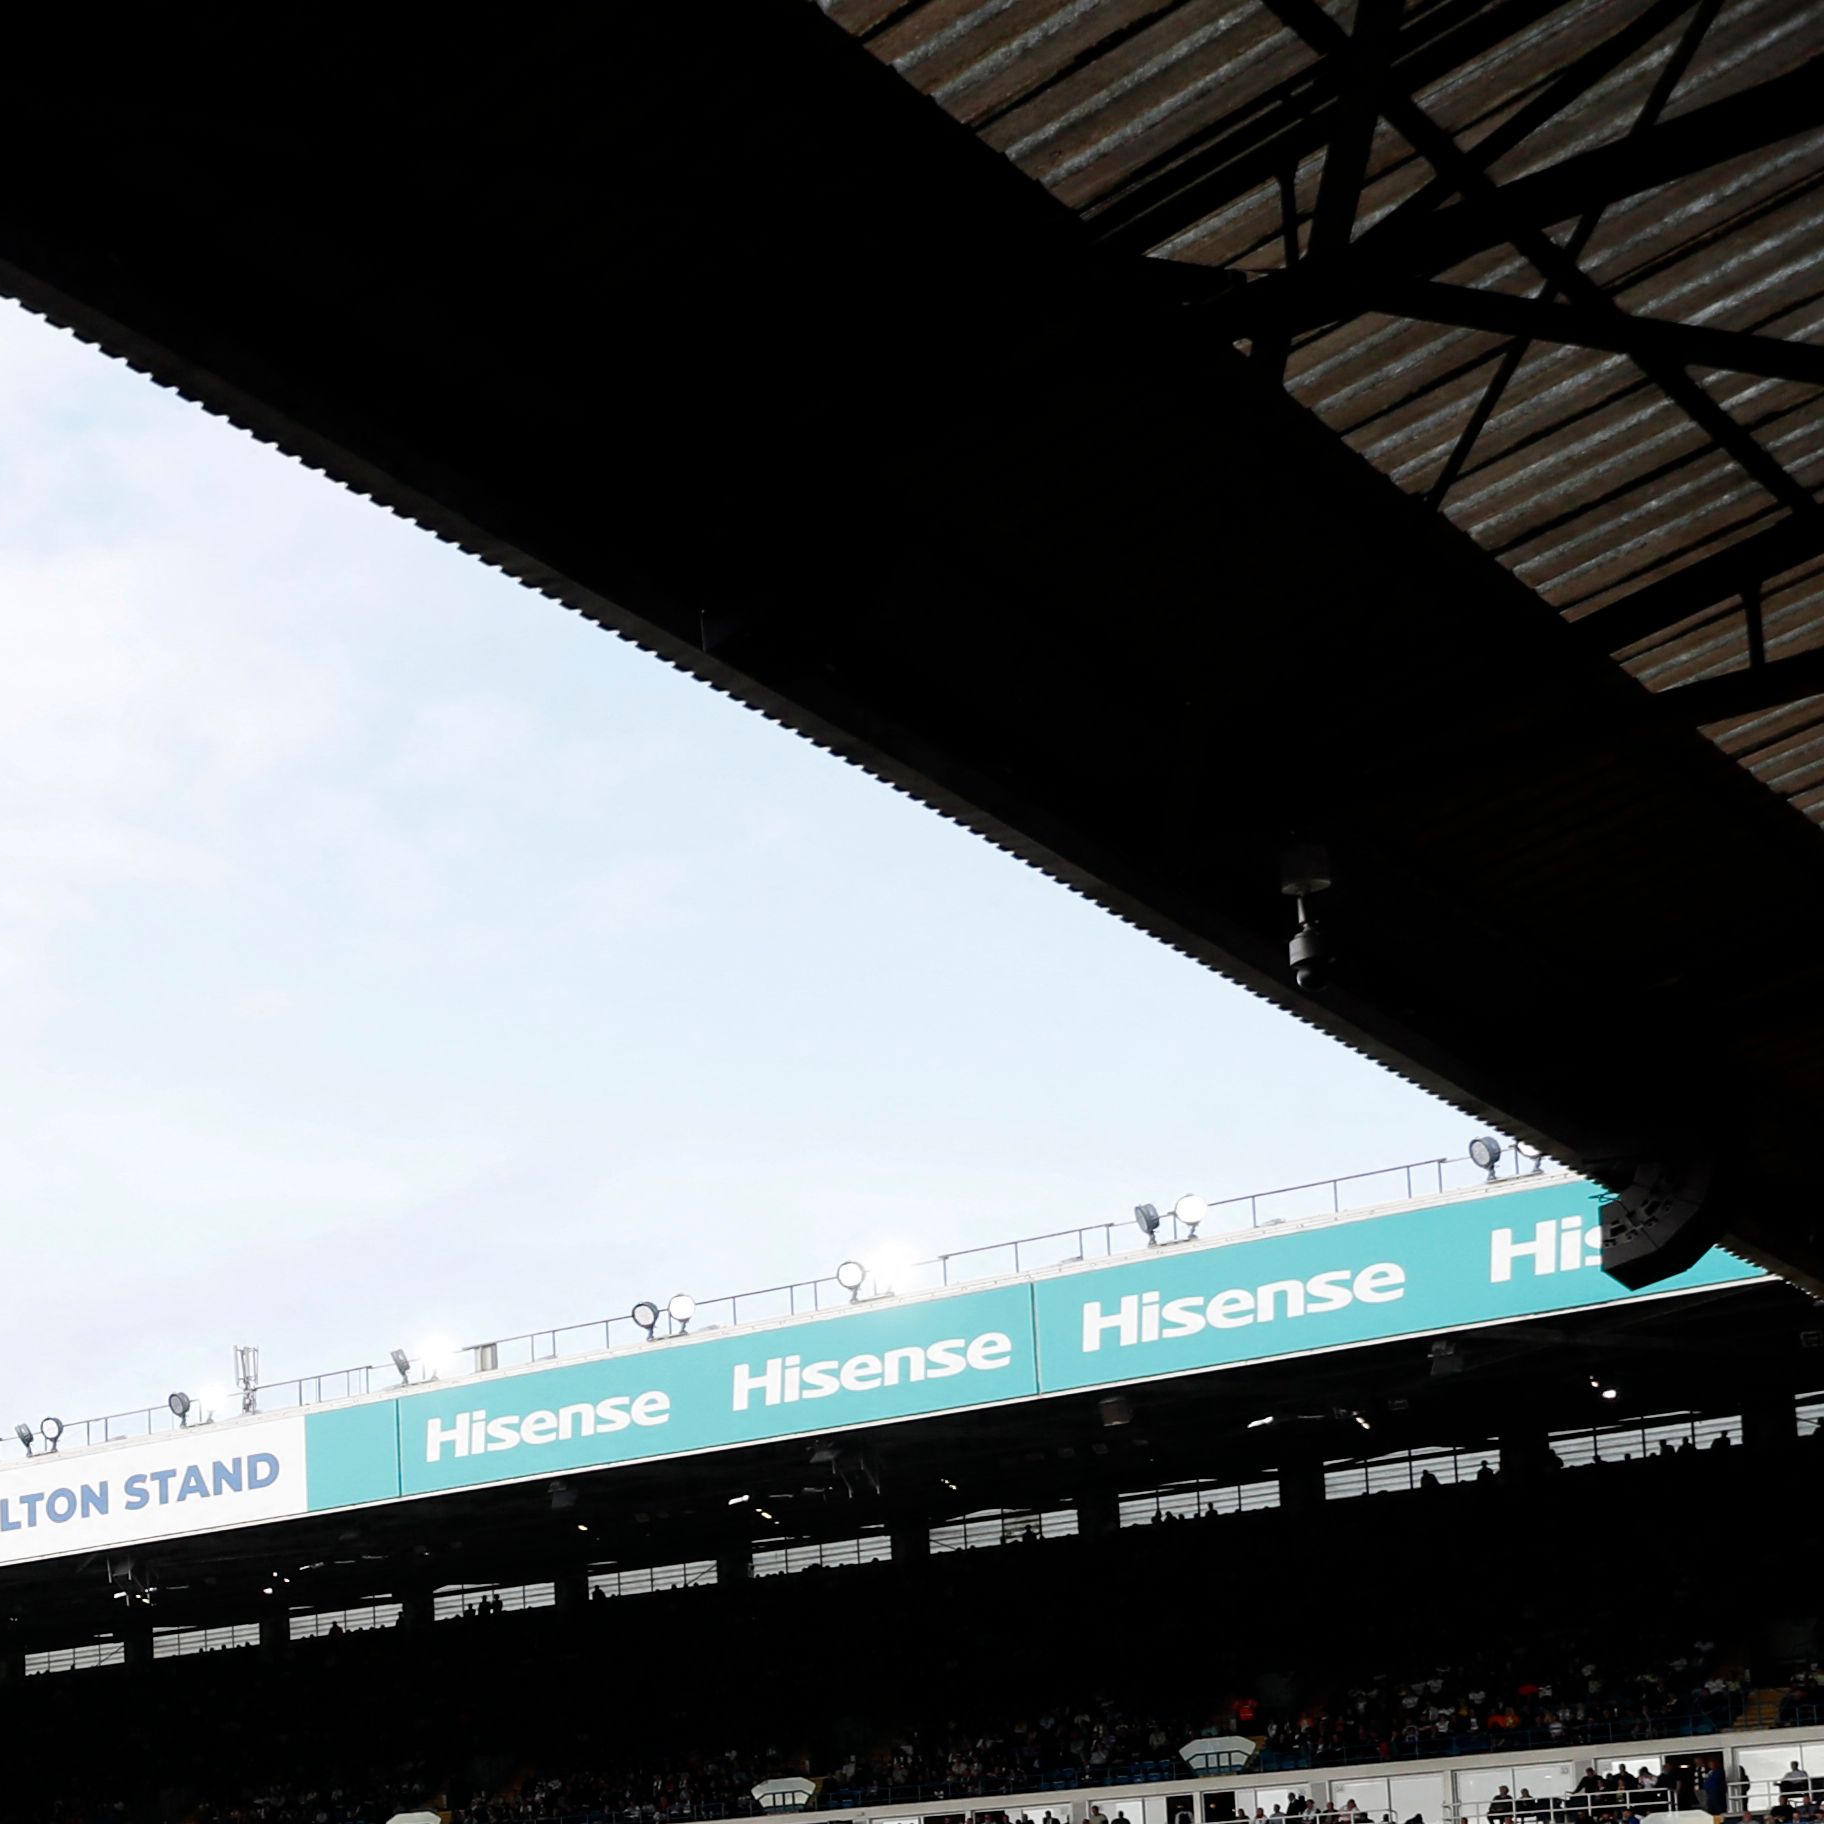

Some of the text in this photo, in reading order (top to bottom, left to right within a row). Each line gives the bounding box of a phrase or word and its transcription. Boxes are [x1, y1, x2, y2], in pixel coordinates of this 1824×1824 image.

[1082, 1262, 1405, 1352] Hisense
[732, 1328, 1012, 1412] Hisense
[425, 1390, 671, 1462] Hisense
[124, 1452, 280, 1511] STAND
